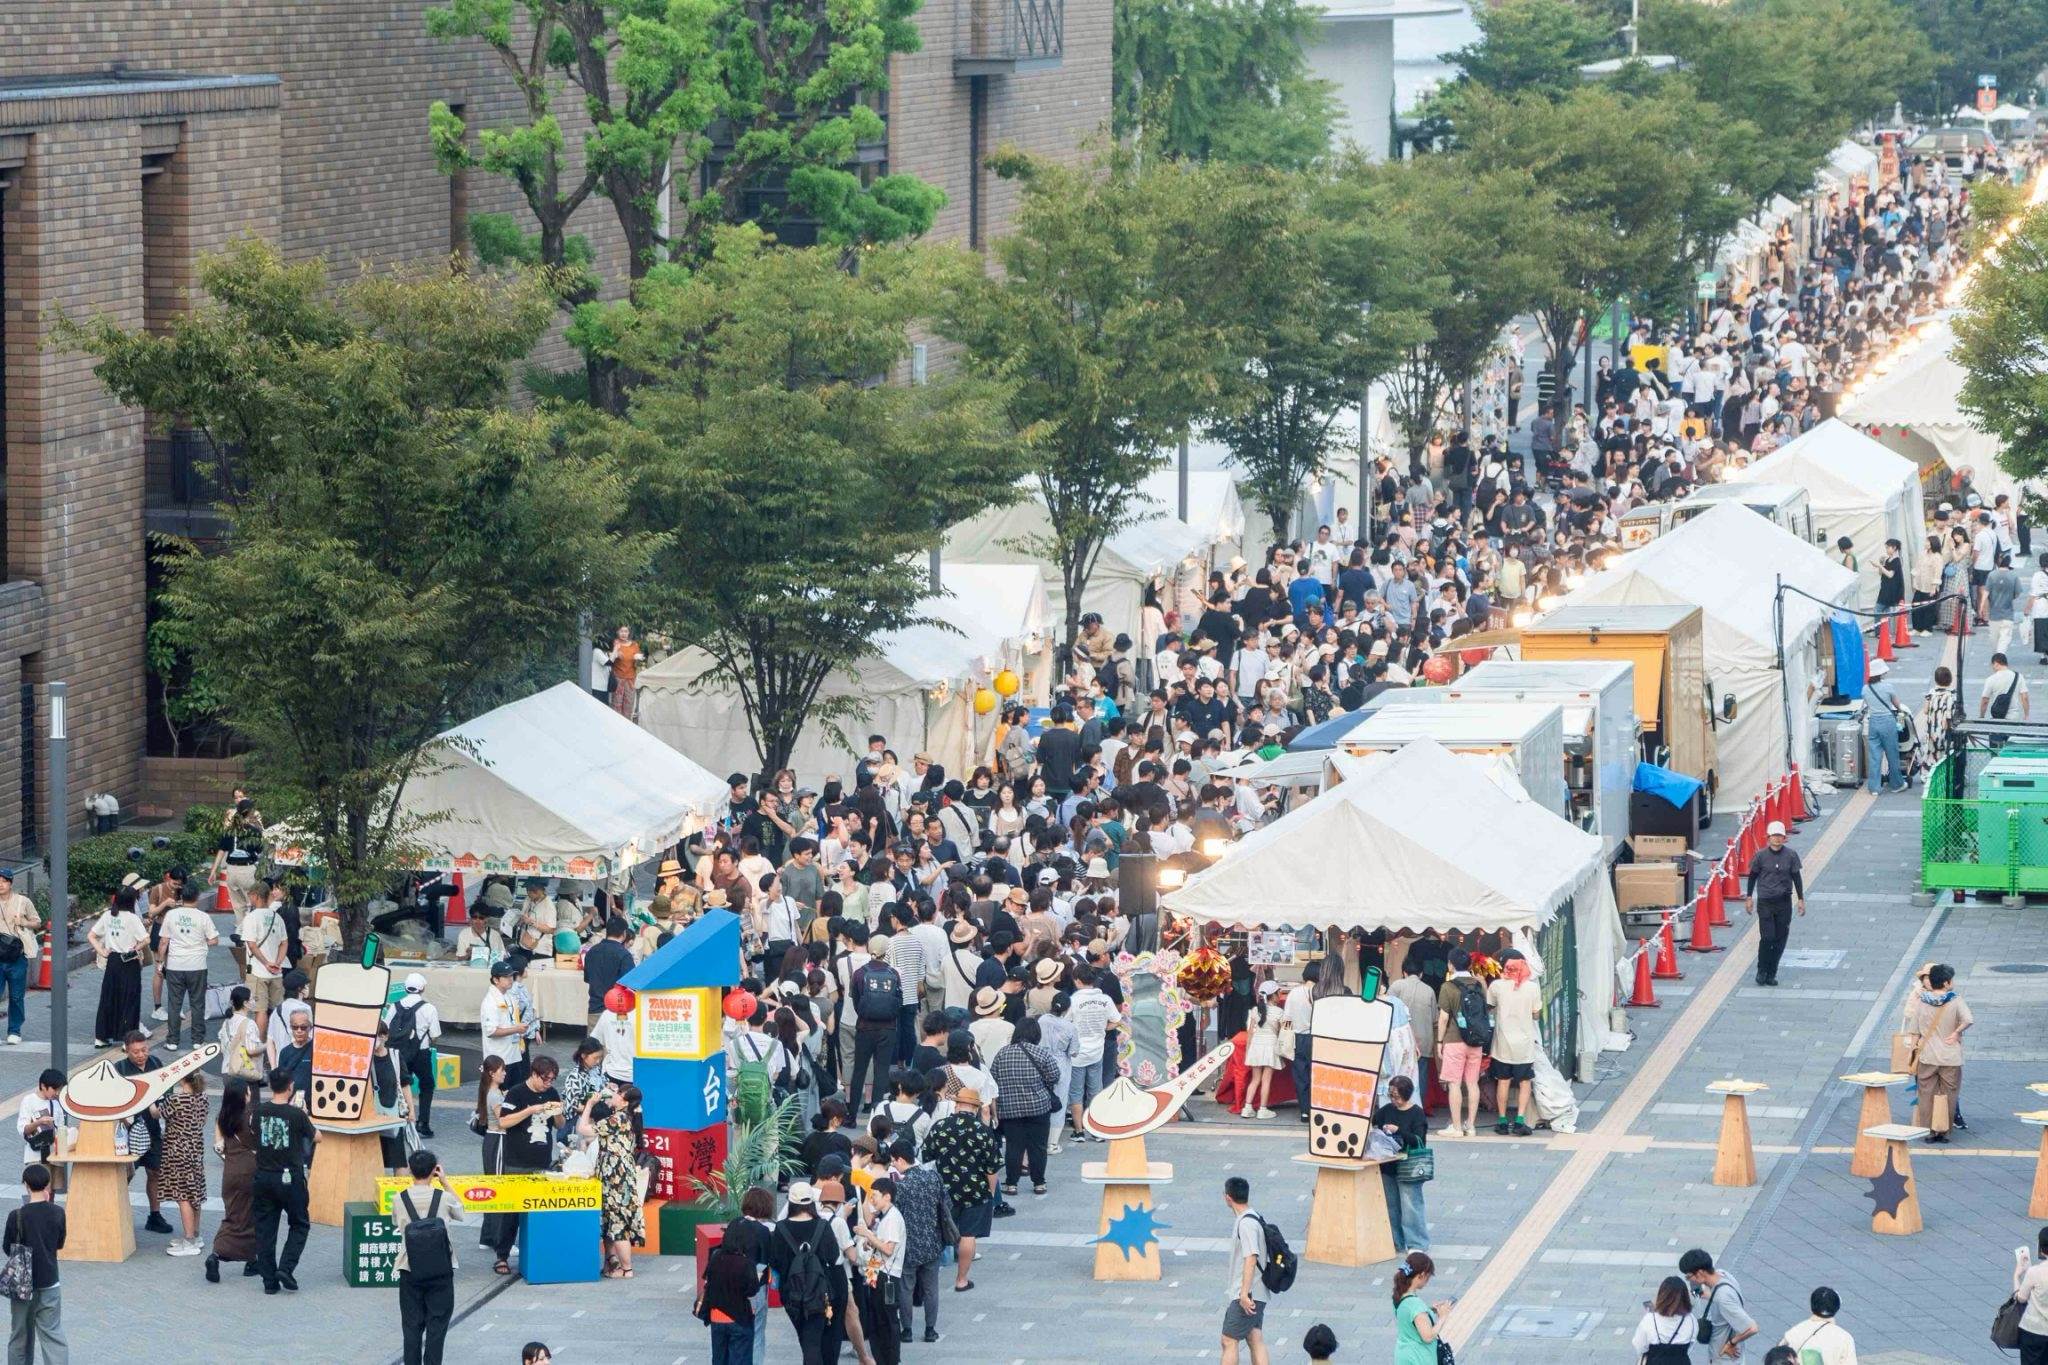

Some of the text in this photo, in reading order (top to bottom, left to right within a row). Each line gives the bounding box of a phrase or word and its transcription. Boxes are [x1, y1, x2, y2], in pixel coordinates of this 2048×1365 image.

[648, 998, 692, 1010] TAIWAN
[703, 1065, 721, 1117] 台
[688, 1135, 717, 1176] 灣
[522, 1197, 597, 1209] STANDARD
